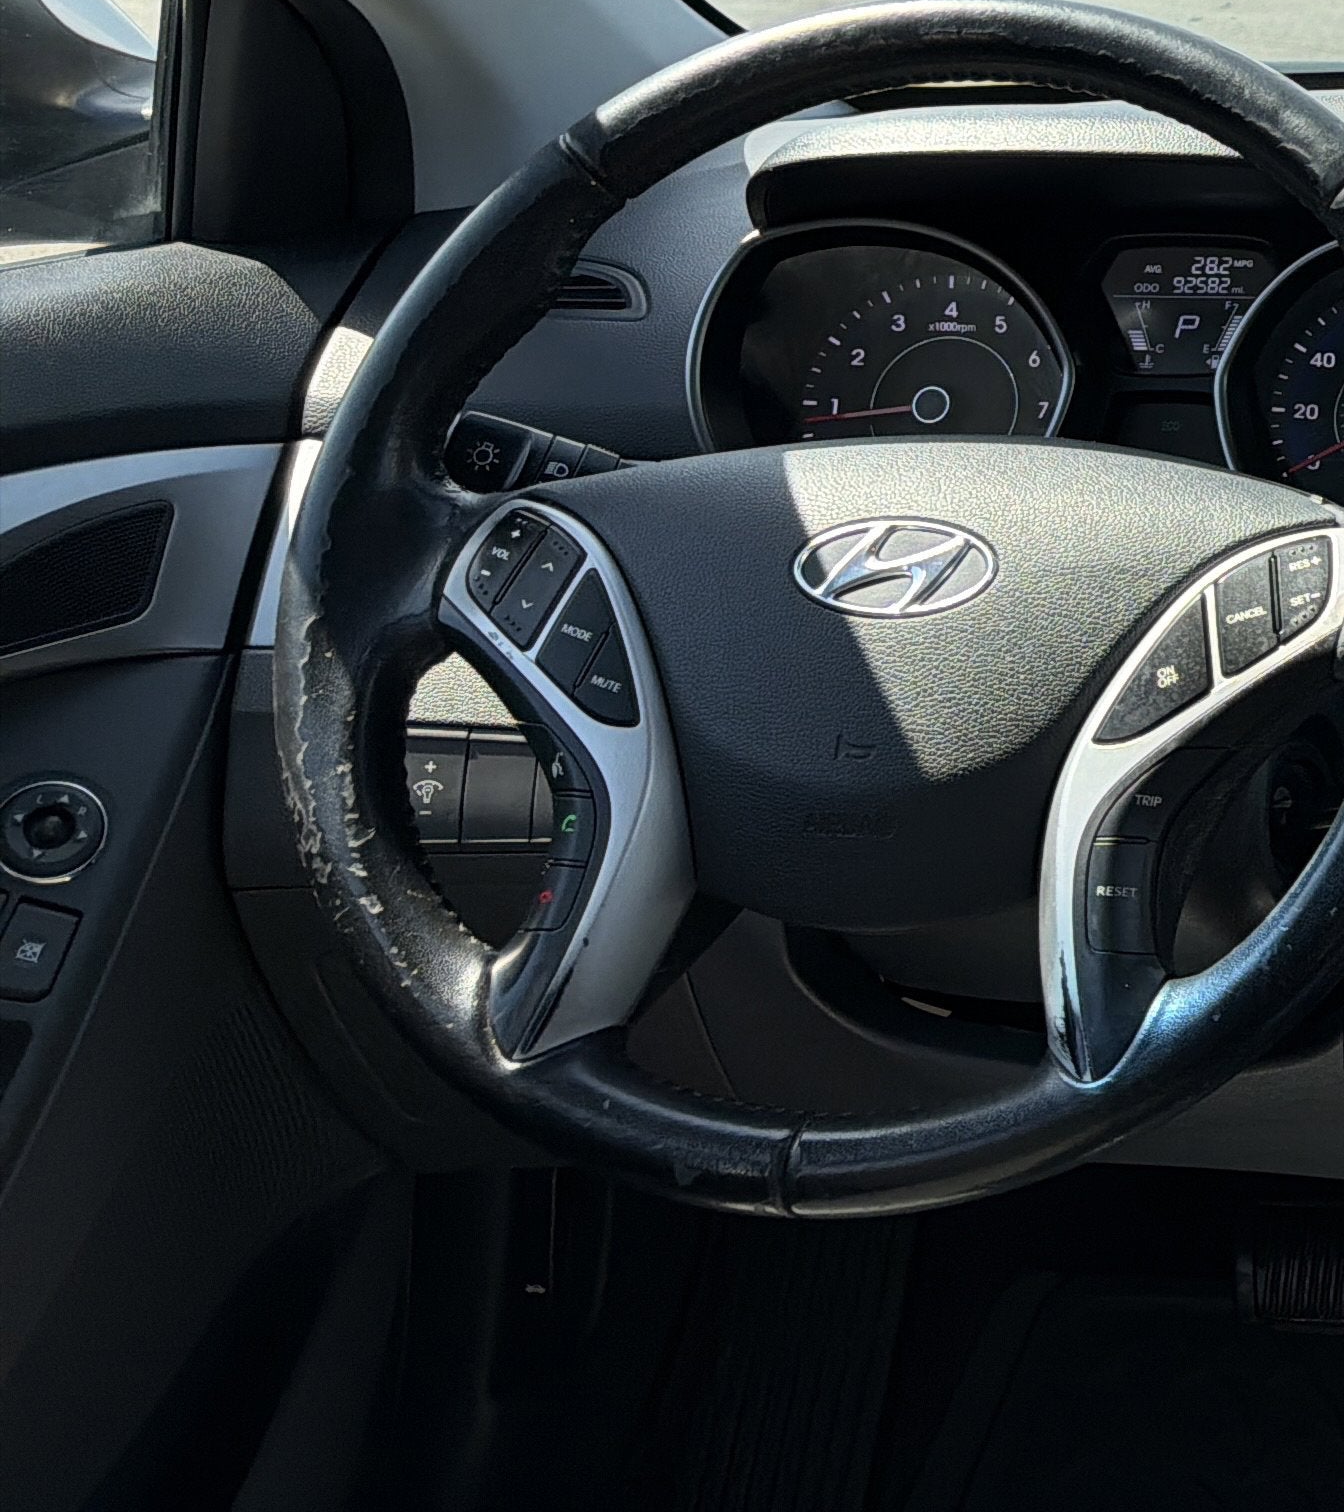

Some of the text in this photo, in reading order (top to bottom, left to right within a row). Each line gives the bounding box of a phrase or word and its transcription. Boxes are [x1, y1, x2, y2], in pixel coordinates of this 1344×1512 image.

[1144, 265, 1162, 274] AVG
[1234, 259, 1254, 268] MPG
[1134, 283, 1160, 293] ODO
[1173, 277, 1231, 294] 92582
[944, 301, 959, 317] 4
[1142, 300, 1151, 309] H
[1225, 301, 1232, 310] F
[891, 315, 906, 331] 3
[994, 317, 1007, 333] 5
[1174, 315, 1200, 339] P
[1155, 344, 1165, 354] C
[1203, 344, 1210, 354] E
[850, 349, 865, 366] 2
[1028, 351, 1041, 367] 6
[1309, 352, 1336, 368] 40
[830, 398, 839, 415] 1
[1038, 402, 1050, 419] 7
[1293, 404, 1319, 420] 20
[491, 546, 510, 561] VOL
[1225, 606, 1268, 625] CANCEL
[560, 623, 593, 643] MODE
[1157, 665, 1176, 678] ON
[590, 674, 622, 694] MUTE
[1157, 675, 1180, 689] OFF
[1134, 794, 1163, 808] TRIP
[1096, 885, 1138, 898] RESET
